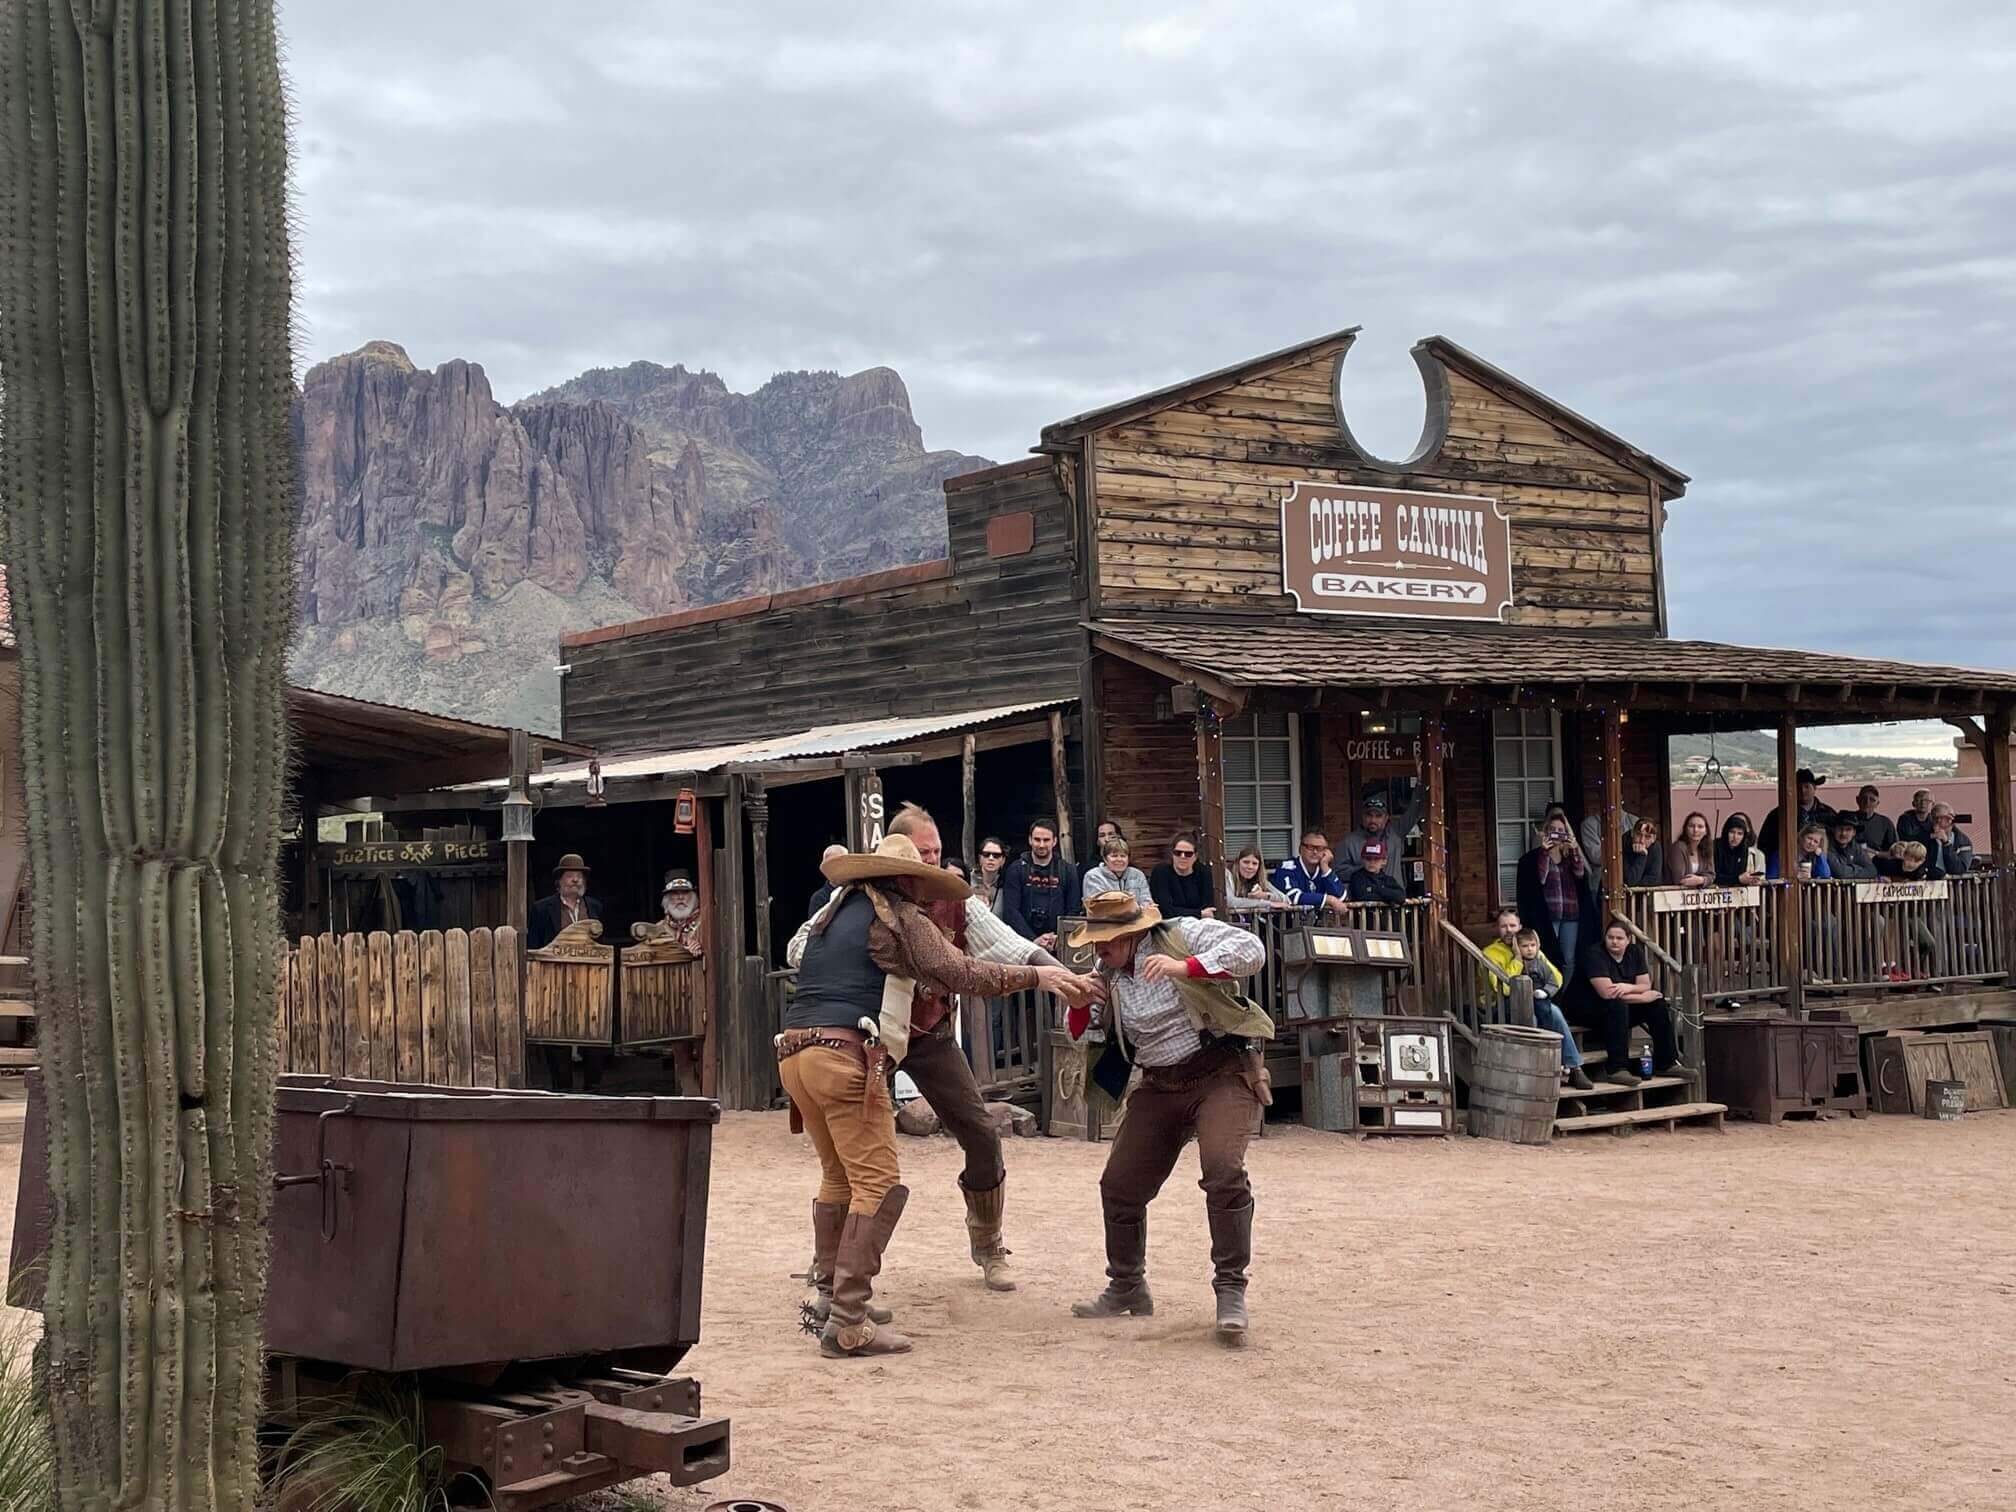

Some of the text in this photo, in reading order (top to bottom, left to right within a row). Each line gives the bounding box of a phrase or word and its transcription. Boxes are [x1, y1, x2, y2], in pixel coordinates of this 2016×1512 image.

[1309, 497, 1489, 576] COFFEE CANTINA
[1321, 577, 1478, 599] BAKERY
[1346, 740, 1391, 760] COFFEE
[1680, 891, 1732, 906] ICED COFFEE
